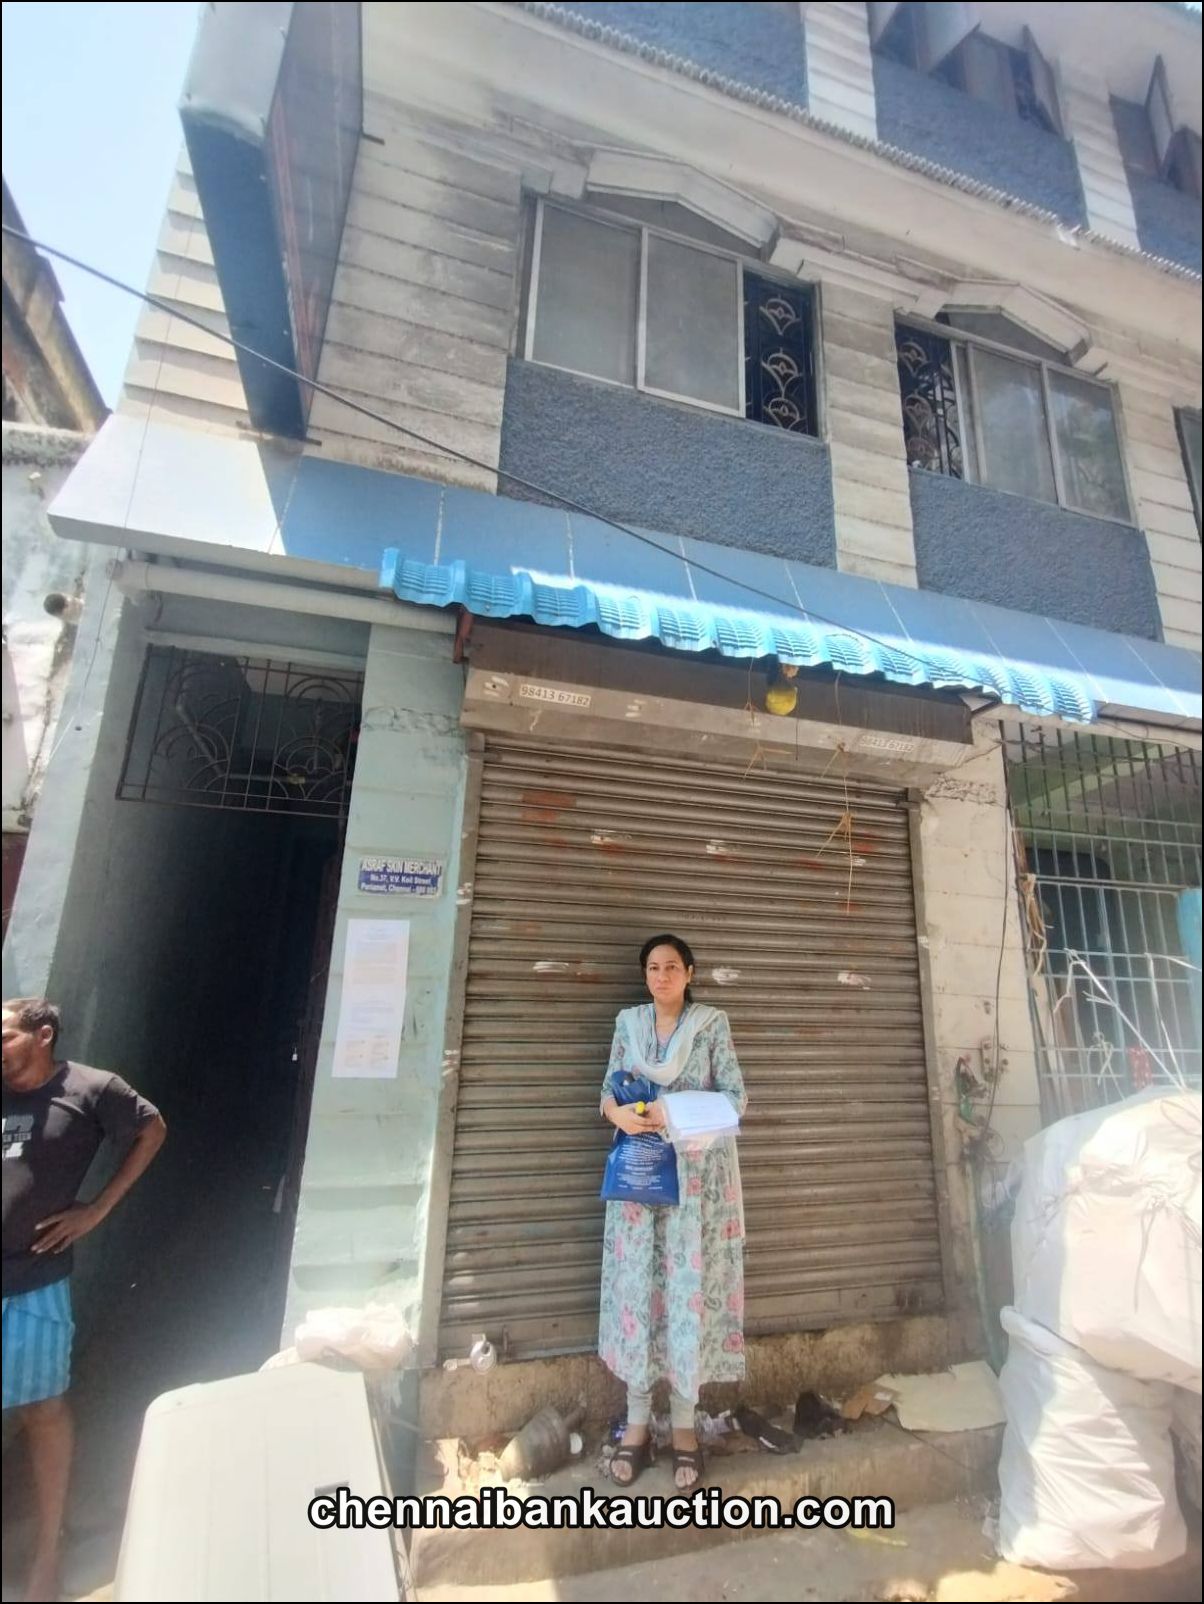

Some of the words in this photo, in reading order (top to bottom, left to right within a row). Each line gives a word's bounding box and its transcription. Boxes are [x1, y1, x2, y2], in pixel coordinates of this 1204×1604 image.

[521, 685, 555, 700] 98413
[558, 692, 589, 706] 67182
[361, 858, 387, 872] ASRAF
[387, 859, 402, 873] SKIN
[404, 860, 441, 876] MERCHANT
